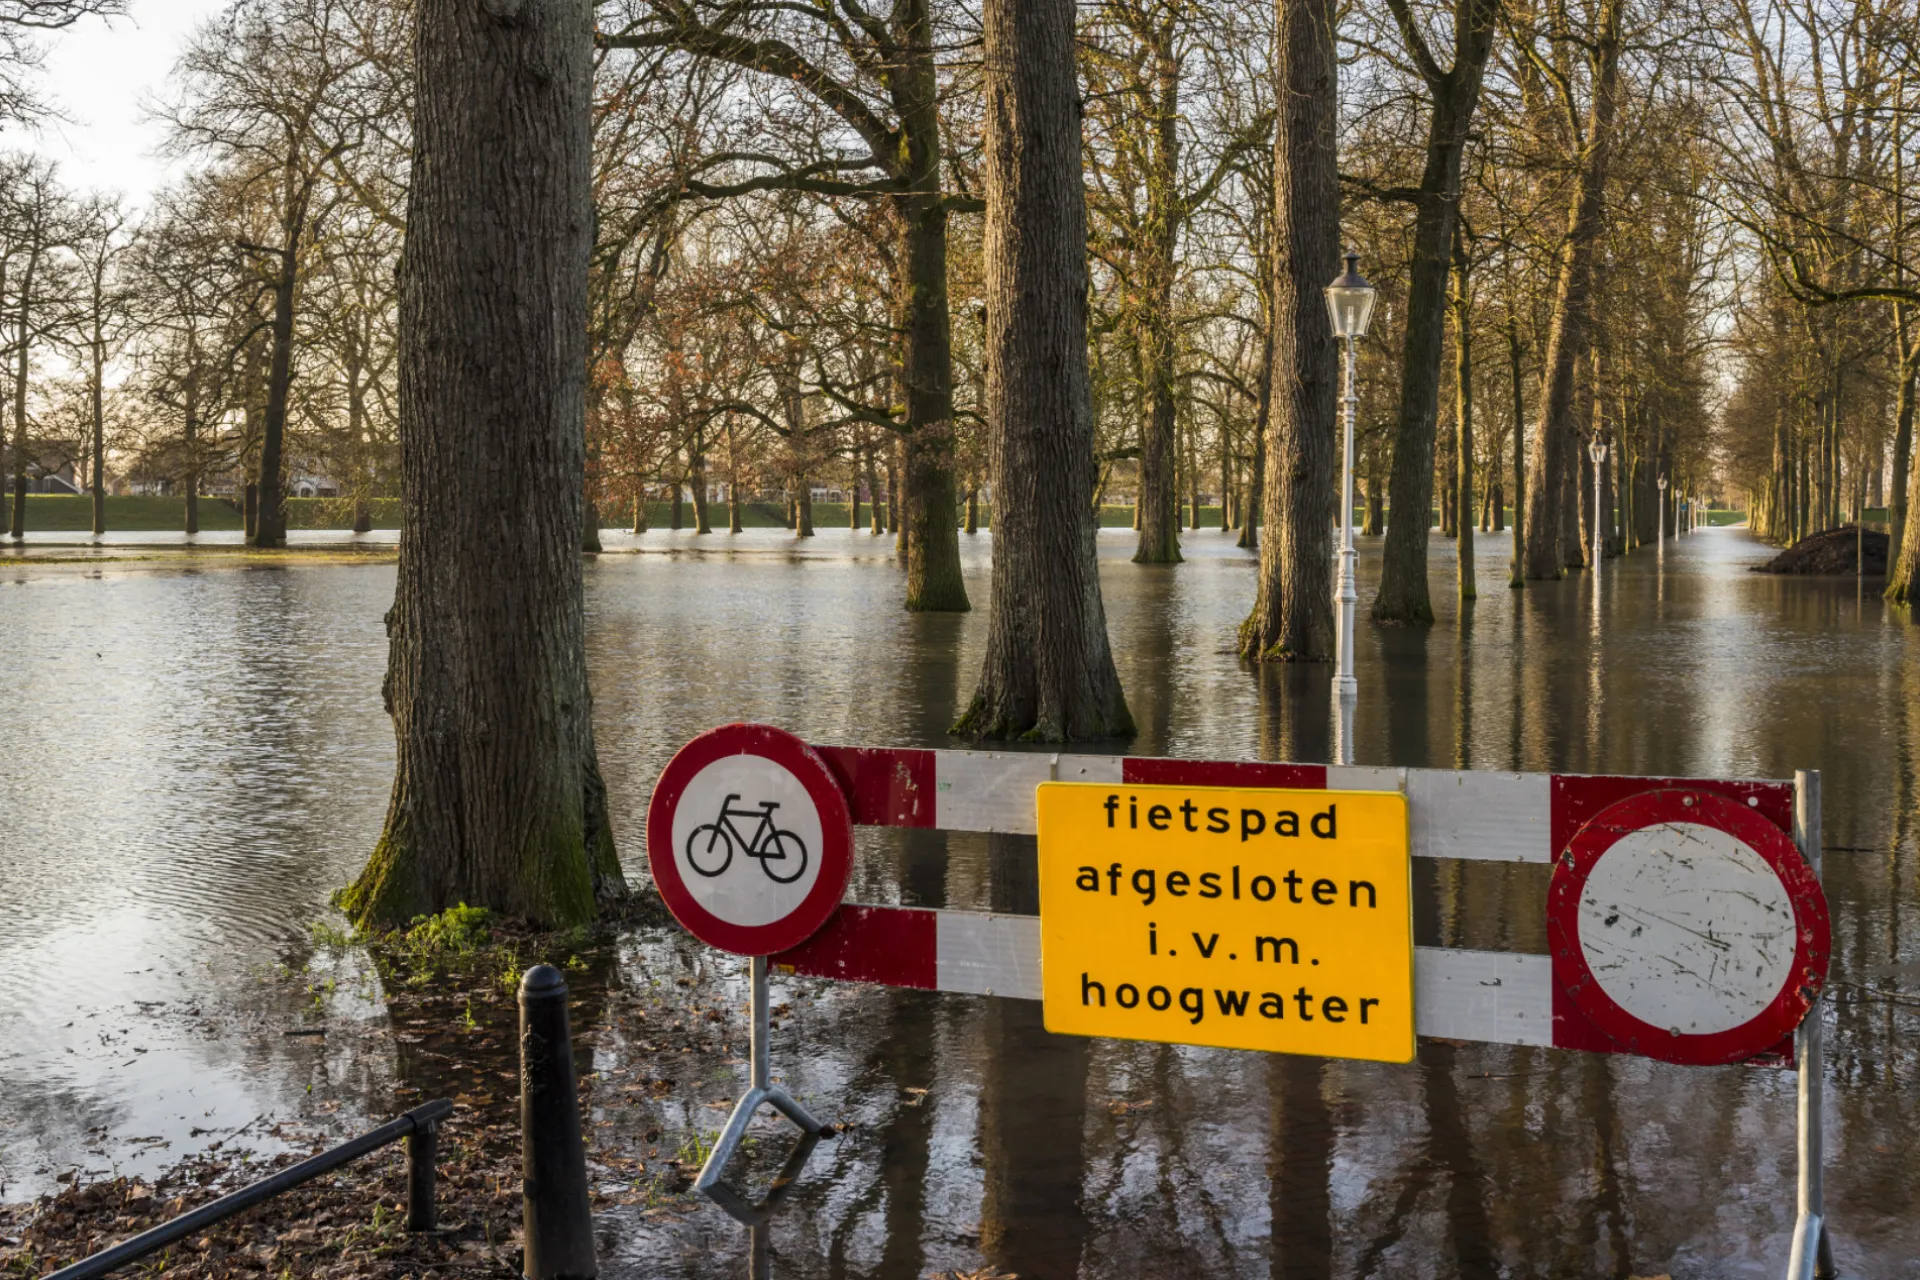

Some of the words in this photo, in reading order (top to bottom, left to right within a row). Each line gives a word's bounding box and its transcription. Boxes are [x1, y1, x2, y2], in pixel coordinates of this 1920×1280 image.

[1103, 794, 1337, 842] fietspad
[1075, 862, 1377, 909] afgesloten
[1148, 921, 1321, 966] i.v.m.
[1080, 972, 1380, 1025] hoogwater
